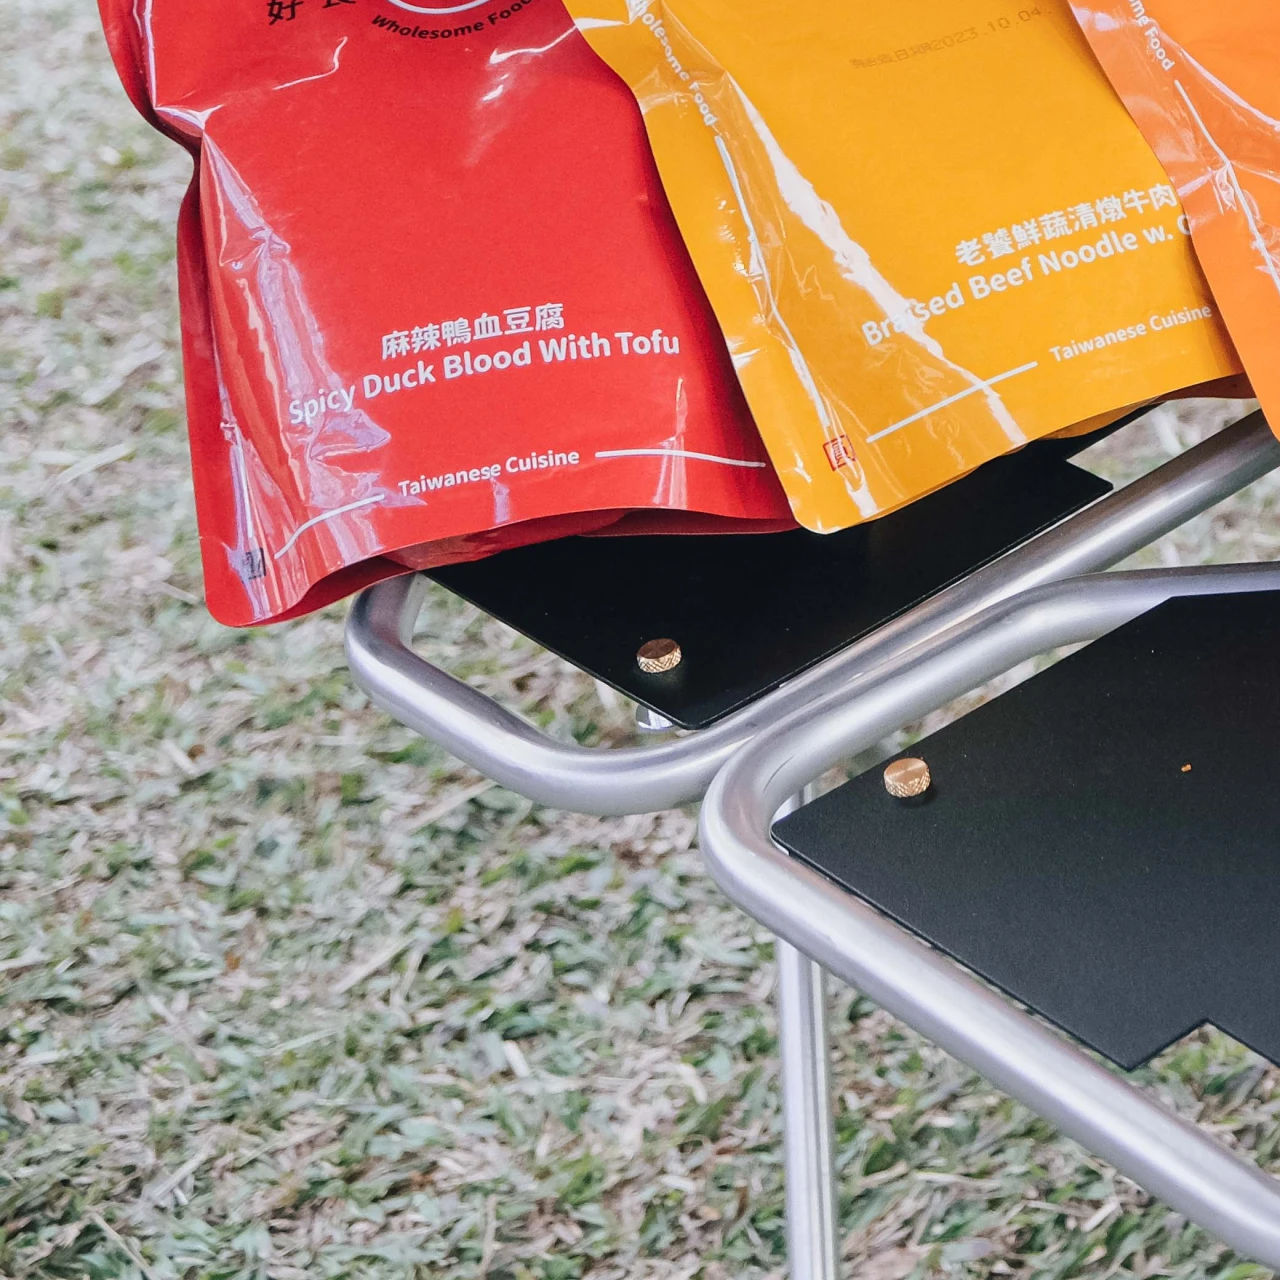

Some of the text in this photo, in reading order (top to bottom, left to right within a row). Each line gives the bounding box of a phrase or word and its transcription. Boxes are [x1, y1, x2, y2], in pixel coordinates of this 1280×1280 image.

[370, 14, 485, 40] Wholesome
[1144, 26, 1176, 71] Food
[688, 81, 718, 126] Food
[861, 282, 965, 347] Braised
[968, 255, 1034, 301] Beef
[1037, 230, 1139, 276] Noodle
[1142, 225, 1175, 245] w.
[381, 302, 565, 361] 麻辣鴨血豆腐
[1048, 303, 1213, 363] Taiwanese Cuisine
[288, 328, 680, 426] Spicy Duck Blood With Tofu
[397, 449, 580, 497] Taiwanese Cuisine
